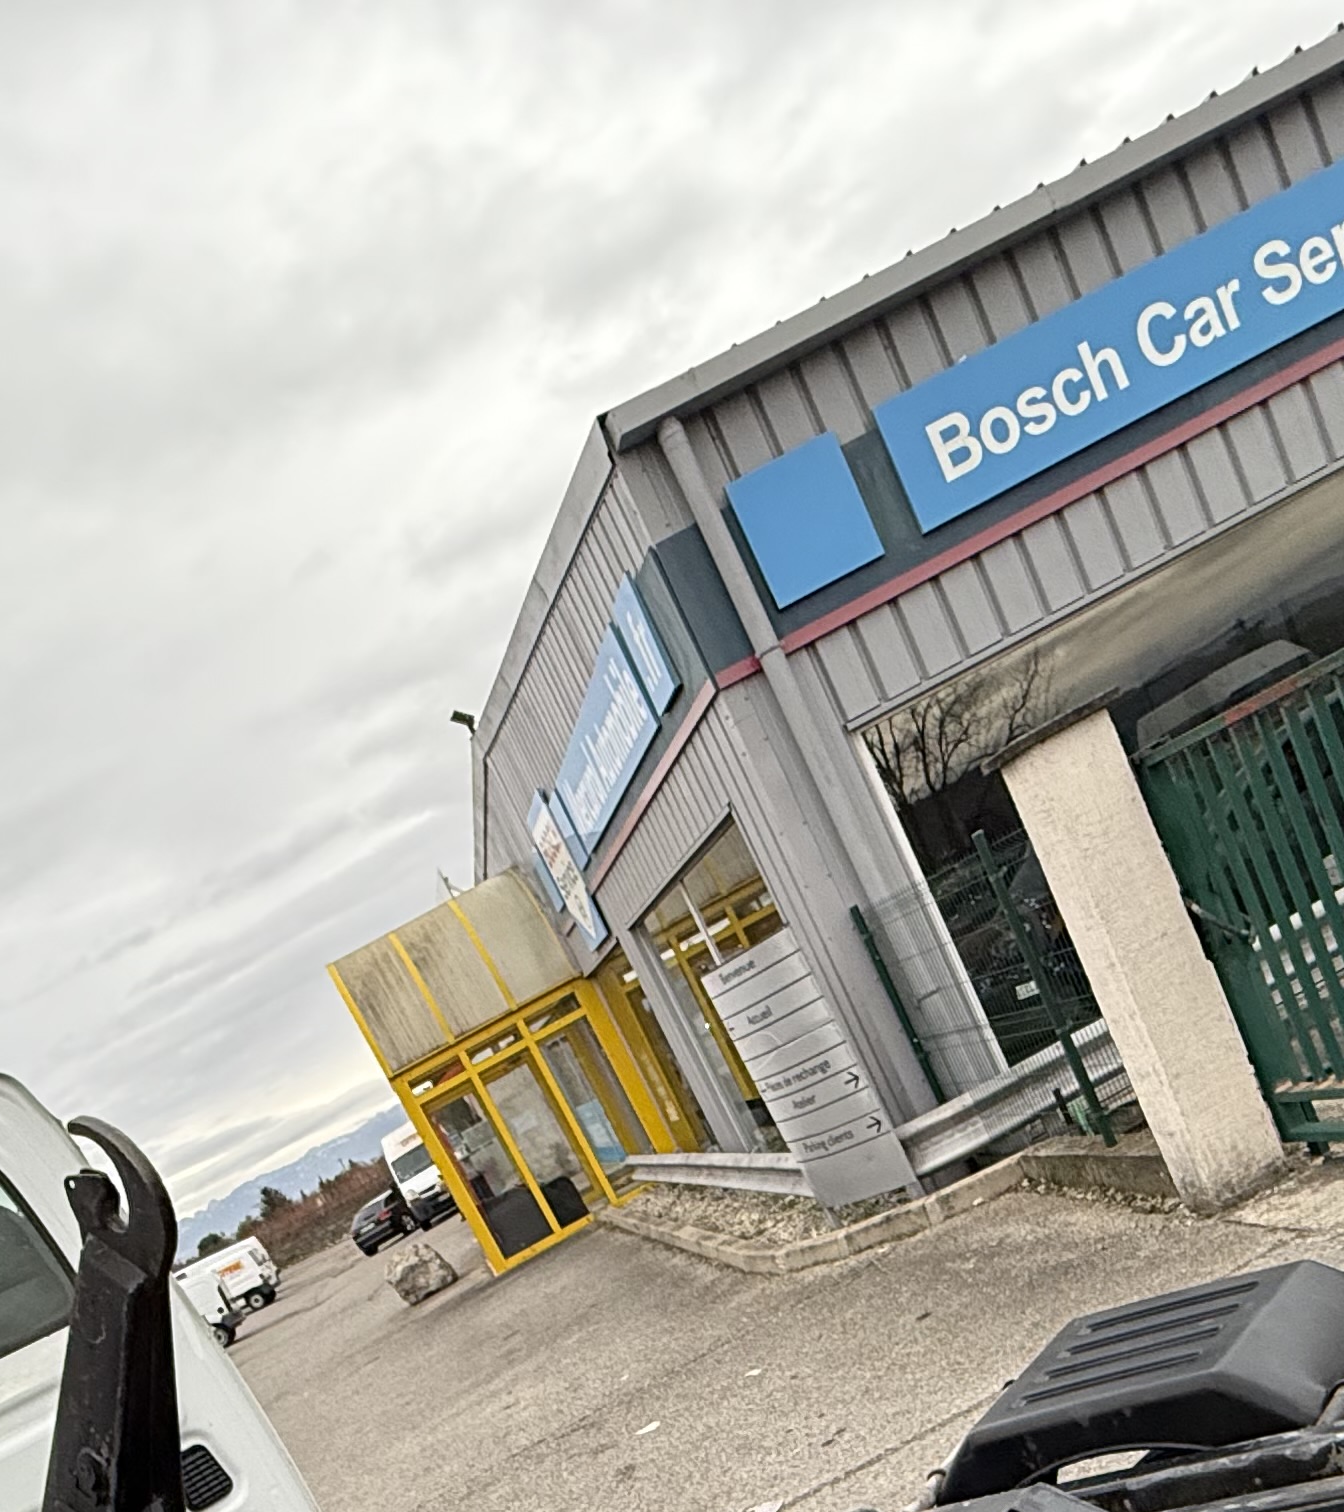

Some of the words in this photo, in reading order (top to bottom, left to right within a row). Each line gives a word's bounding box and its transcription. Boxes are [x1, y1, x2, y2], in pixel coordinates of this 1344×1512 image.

[925, 343, 1130, 483] Bosch
[1136, 278, 1241, 367] Car
[792, 1060, 831, 1083] rechange
